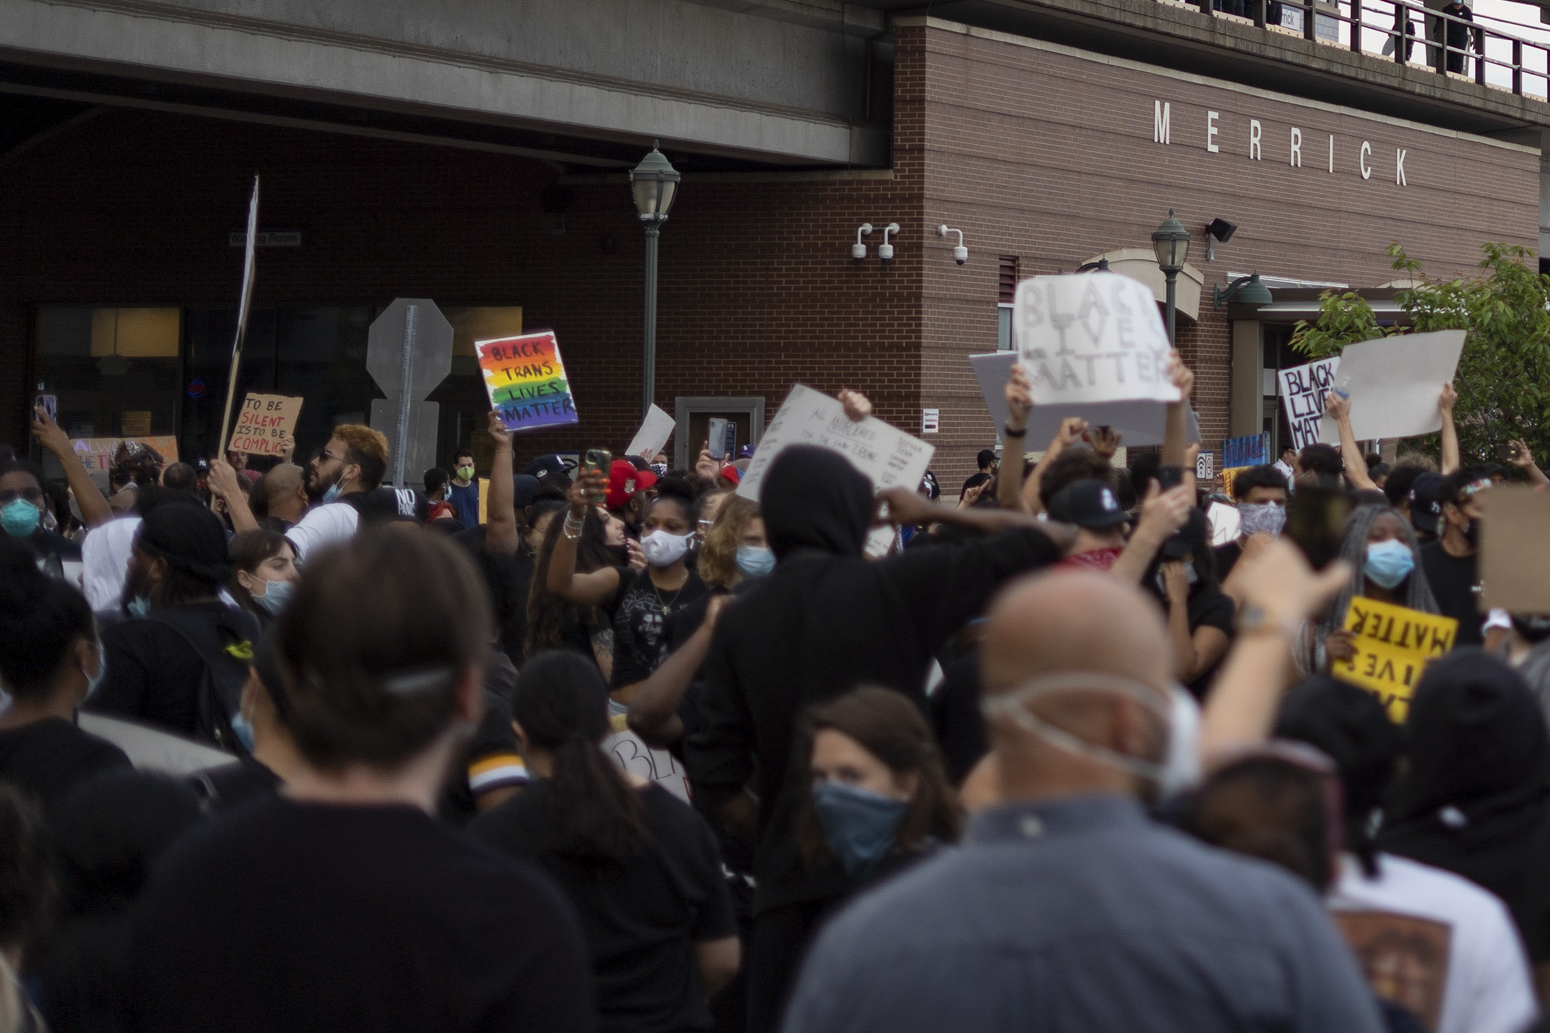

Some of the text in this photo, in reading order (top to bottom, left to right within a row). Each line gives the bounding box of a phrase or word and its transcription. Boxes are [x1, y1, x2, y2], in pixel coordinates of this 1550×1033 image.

[1154, 100, 1407, 186] MERRICK
[269, 233, 297, 242] Room
[1022, 316, 1166, 359] LIVES
[491, 342, 545, 361] BLACK
[501, 361, 554, 380] TRANS
[1284, 362, 1335, 396] BLACK
[508, 381, 561, 400] LIVES
[245, 398, 283, 411] TO BE
[502, 397, 577, 422] MATTER
[1290, 387, 1331, 418] LIVE
[241, 412, 285, 427] SILENT
[236, 425, 286, 438] IS TO BE
[1291, 413, 1323, 450] MAT
[233, 437, 281, 453] COMPLIC
[79, 455, 96, 469] HE
[395, 488, 416, 504] NO
[1351, 606, 1451, 653] MATTER
